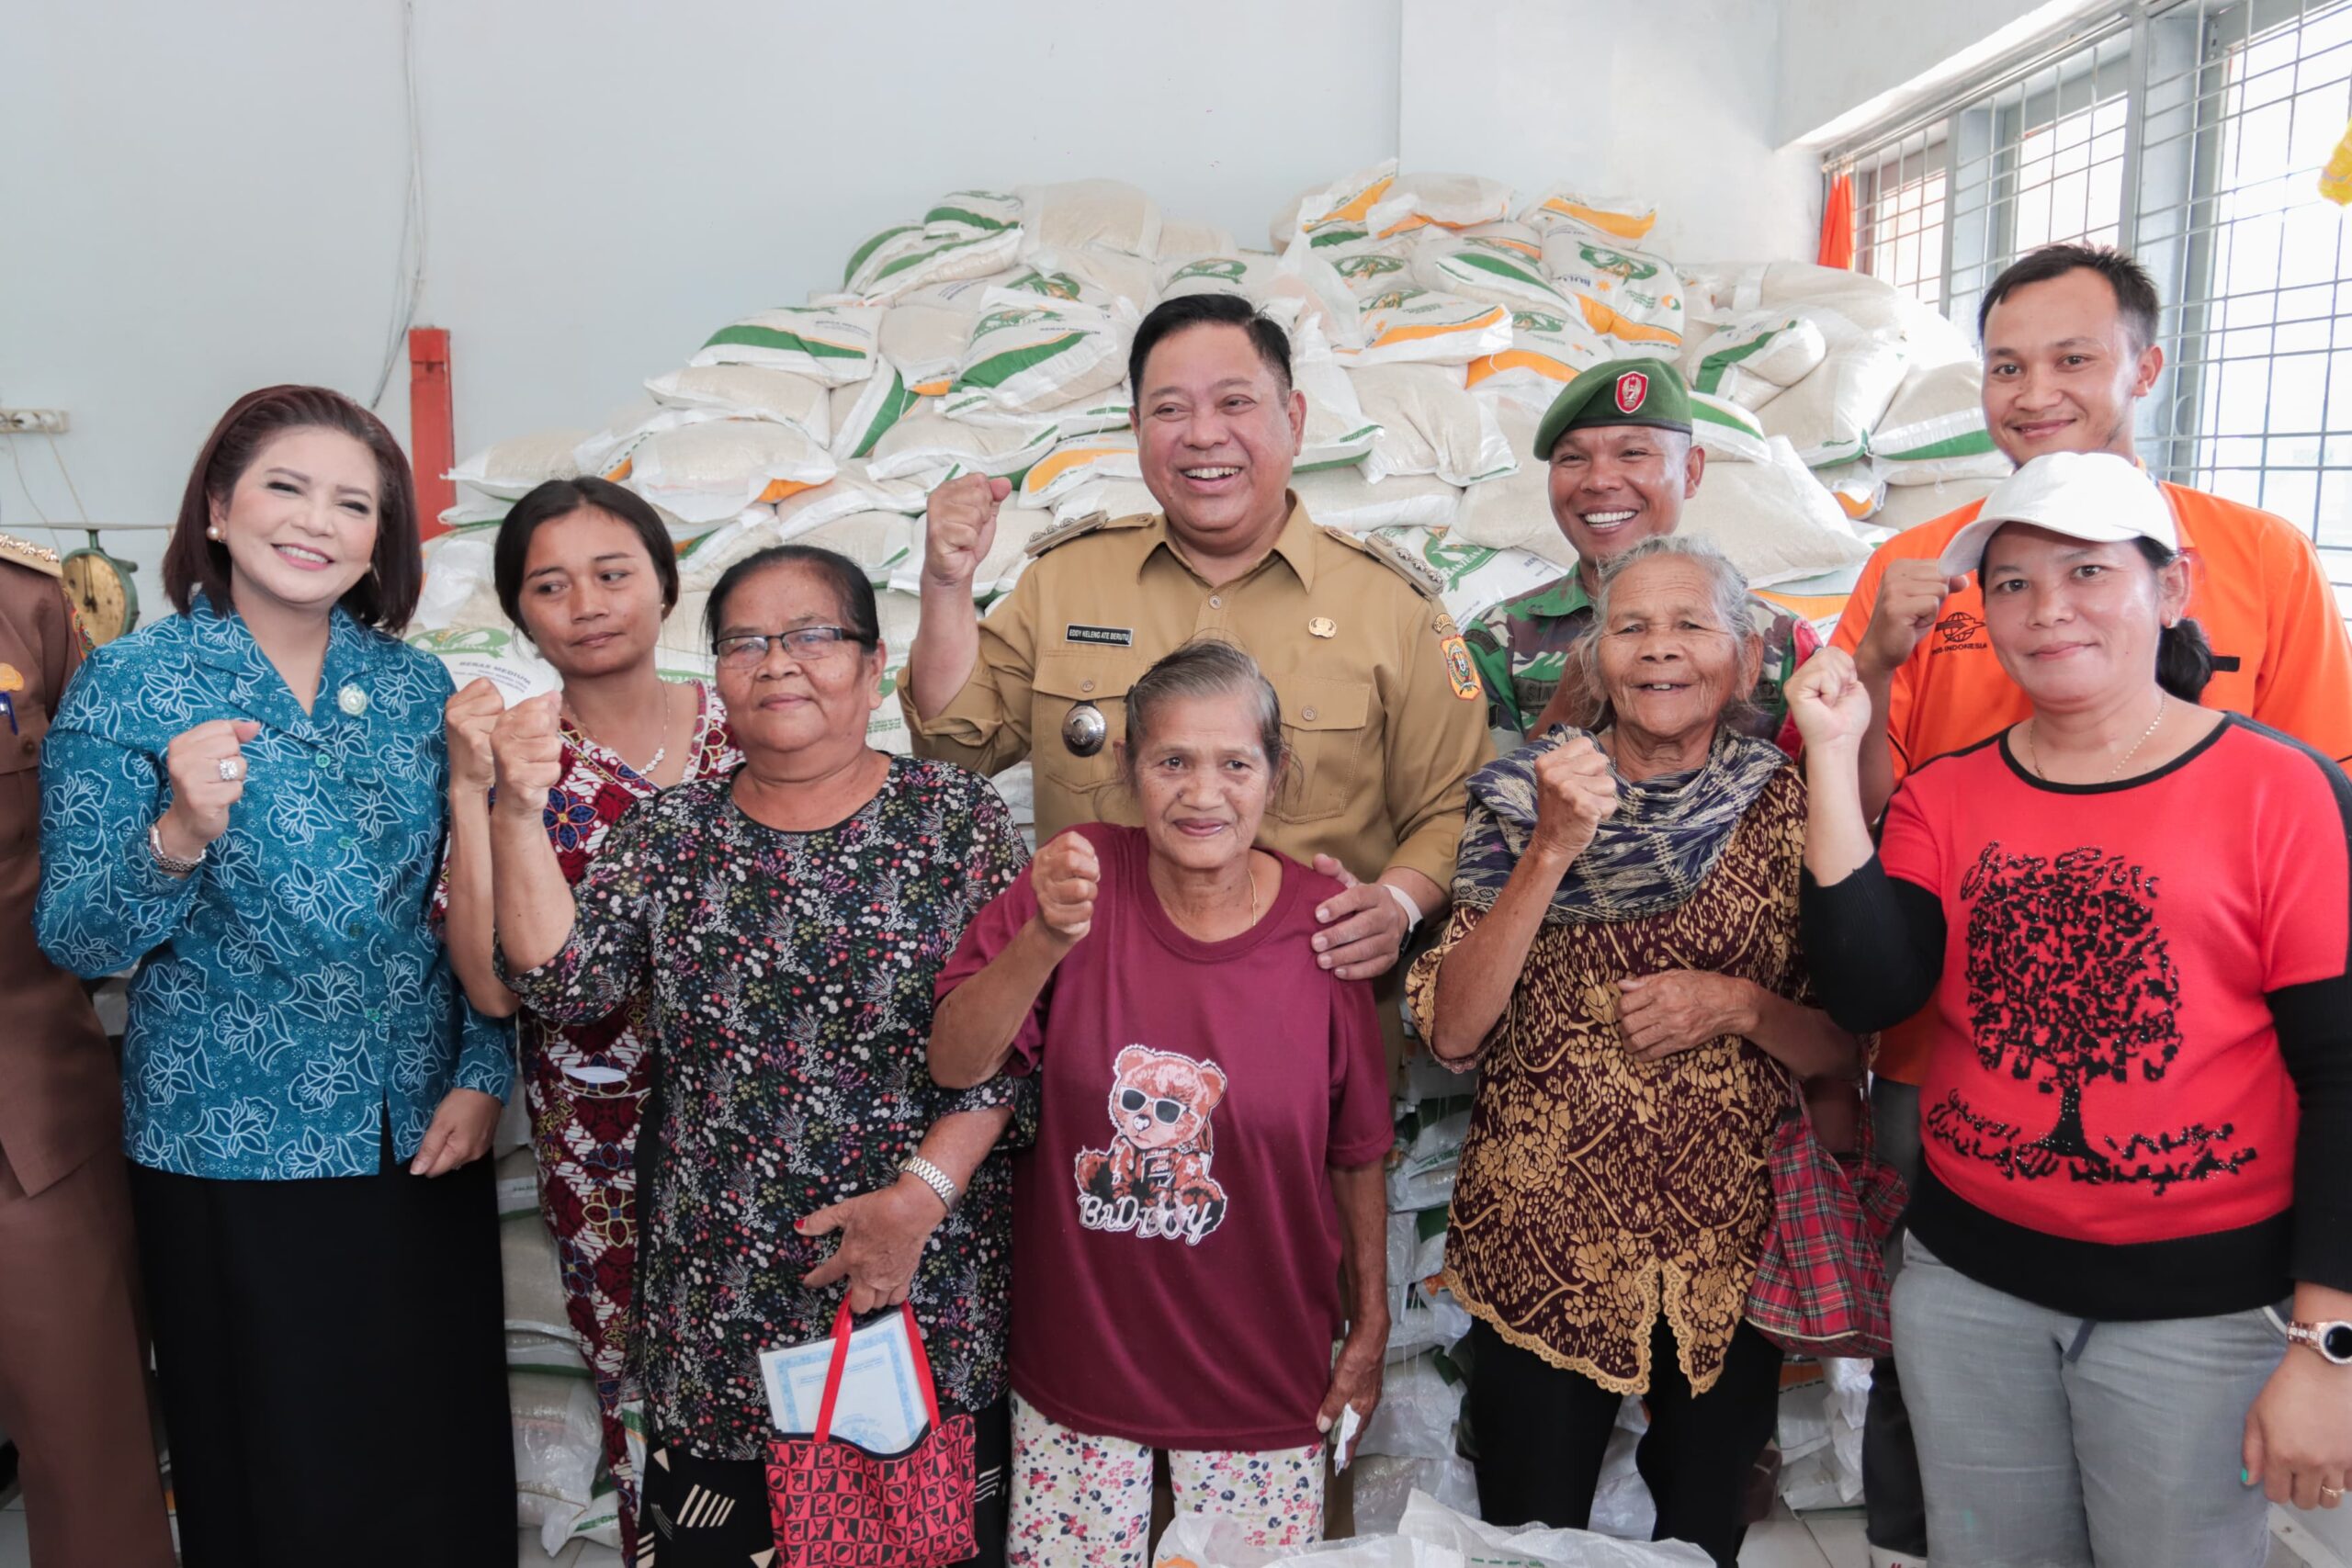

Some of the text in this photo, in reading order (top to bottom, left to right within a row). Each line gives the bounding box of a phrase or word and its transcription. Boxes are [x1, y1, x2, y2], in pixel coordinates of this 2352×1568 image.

[1069, 628, 1129, 641] EDDY KELENG ATE BERUTU
[1944, 643, 1987, 652] INDONESIA
